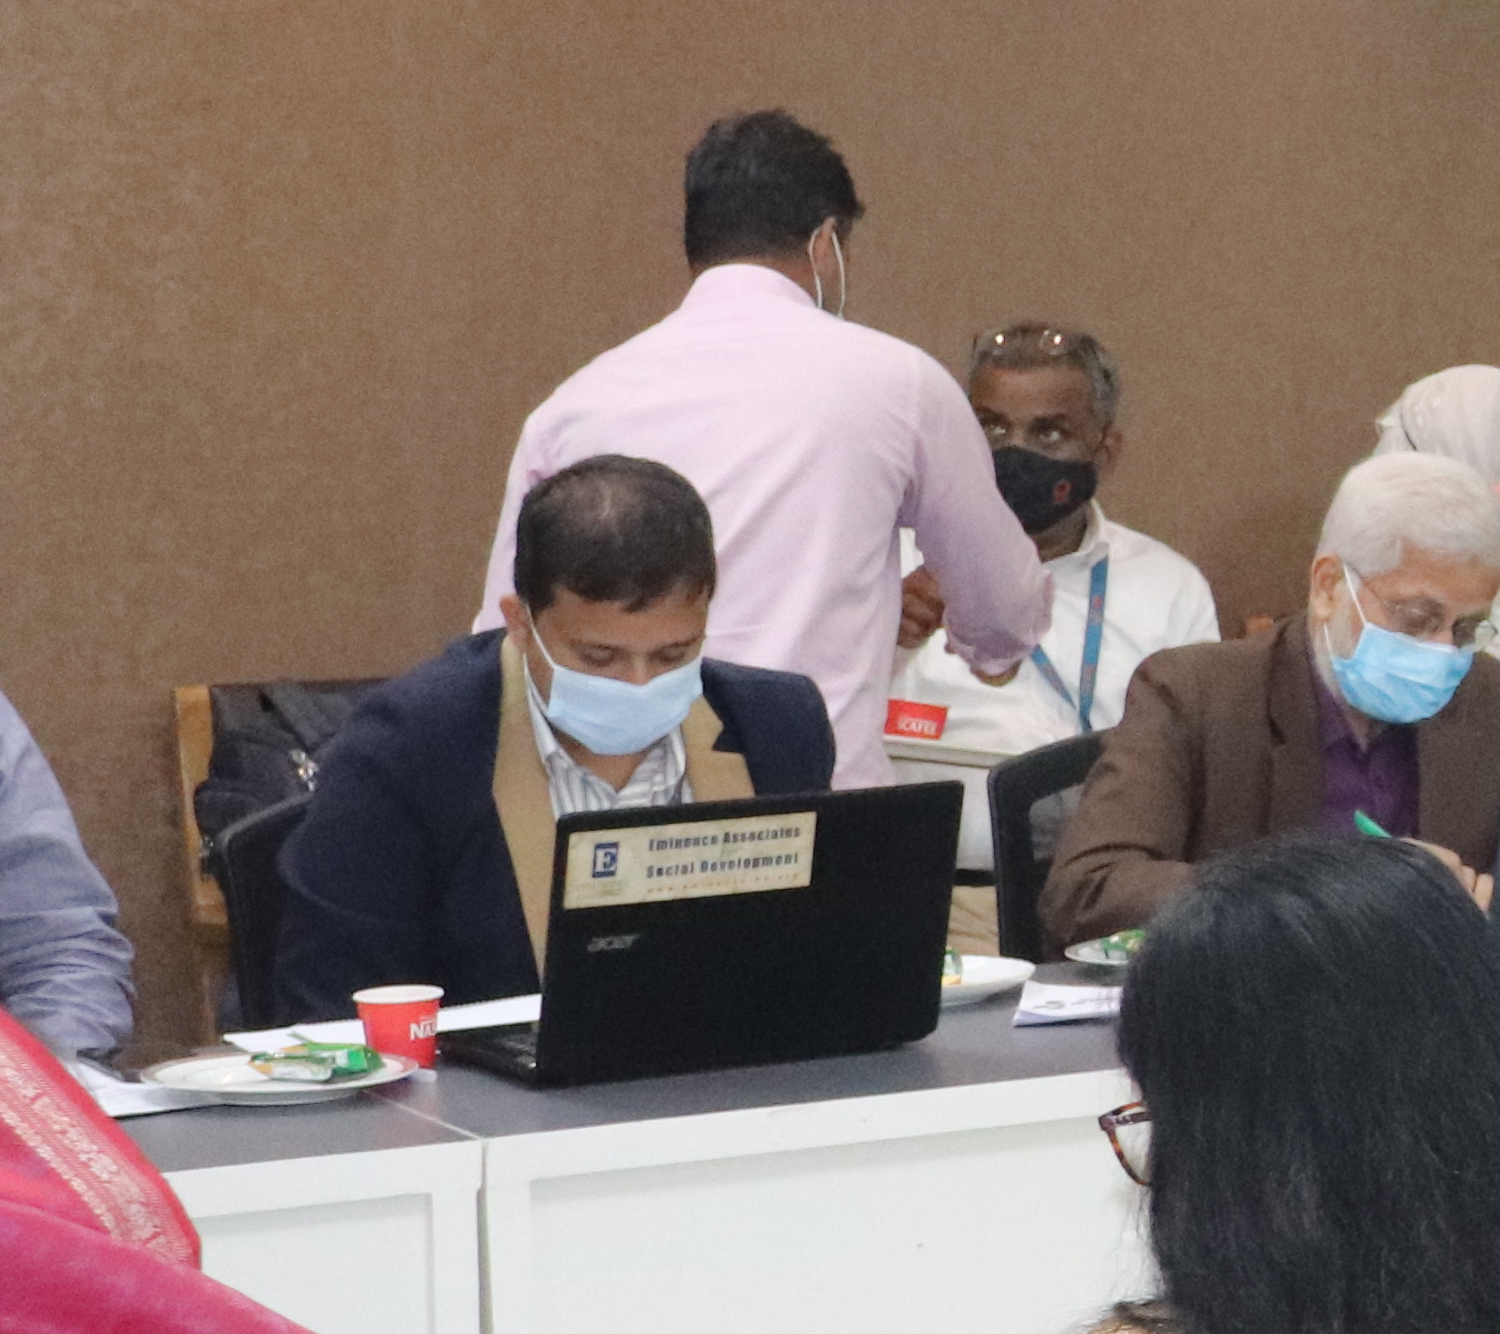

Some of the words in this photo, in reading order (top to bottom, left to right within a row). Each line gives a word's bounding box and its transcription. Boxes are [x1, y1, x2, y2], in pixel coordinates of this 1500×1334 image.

[648, 833, 719, 852] Eminence
[723, 826, 800, 846] Associates
[646, 862, 694, 879] Social
[700, 853, 798, 874] Development
